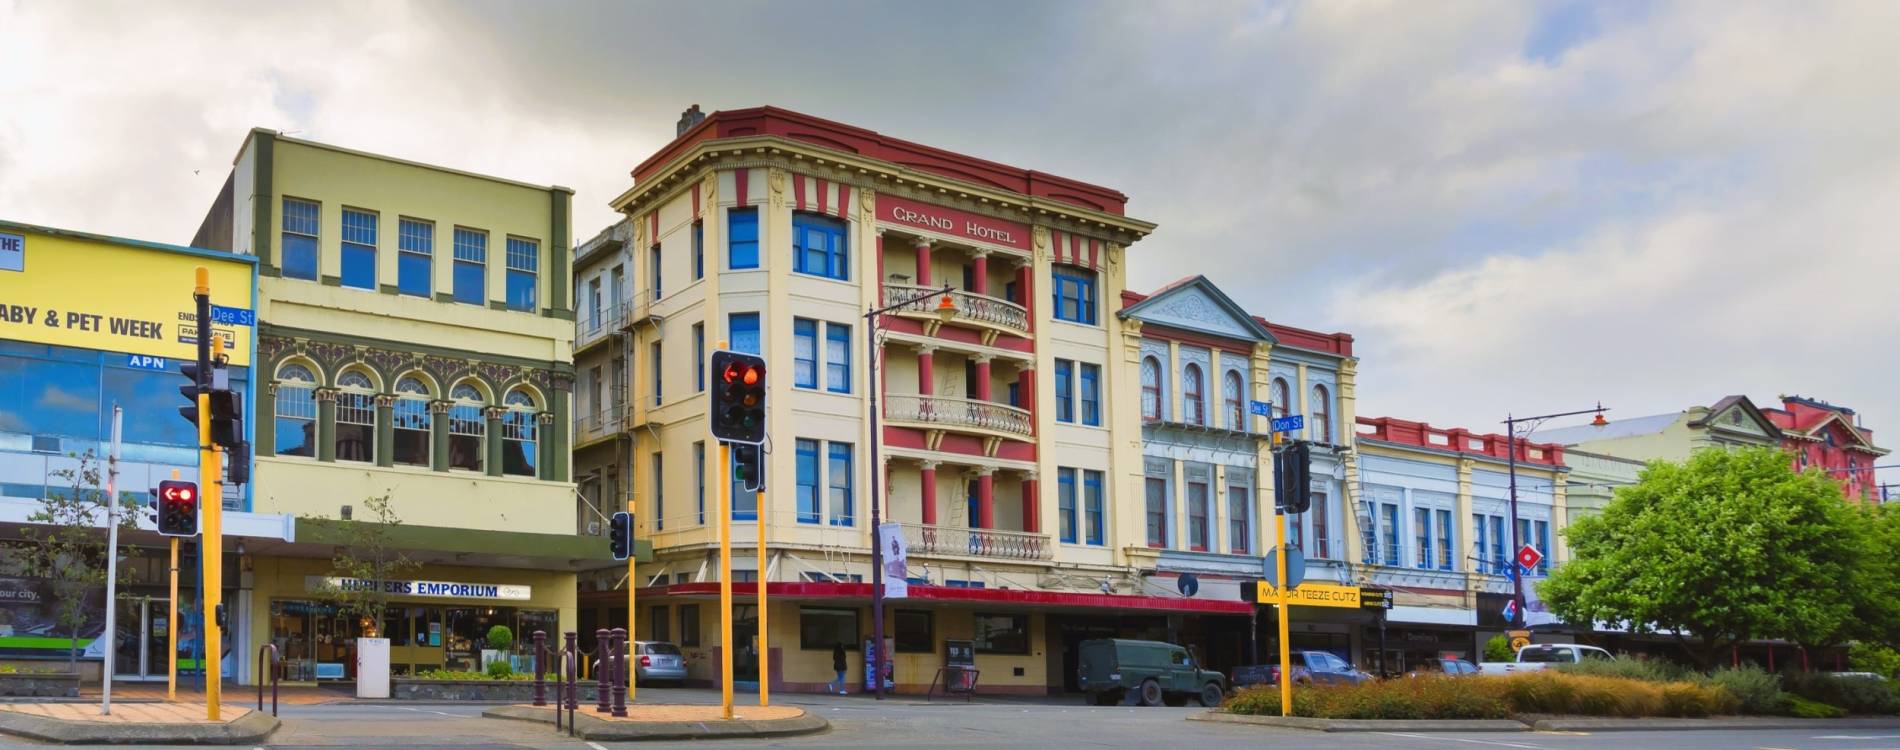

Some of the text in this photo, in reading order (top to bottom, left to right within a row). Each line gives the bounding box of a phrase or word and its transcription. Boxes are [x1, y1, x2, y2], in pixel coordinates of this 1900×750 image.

[893, 207, 1016, 244] GRAND HOTEL
[178, 312, 198, 322] END
[212, 307, 235, 322] Dee
[239, 310, 253, 325] St
[45, 309, 59, 327] &
[66, 311, 103, 333] PET
[109, 316, 163, 339] WEEK
[130, 355, 165, 369] APN
[1274, 416, 1303, 431] Don St
[19, 589, 40, 600] city.
[418, 582, 498, 597] EMPORIUM
[1301, 589, 1330, 600] TEEZE
[1332, 591, 1357, 602] CUTZ
